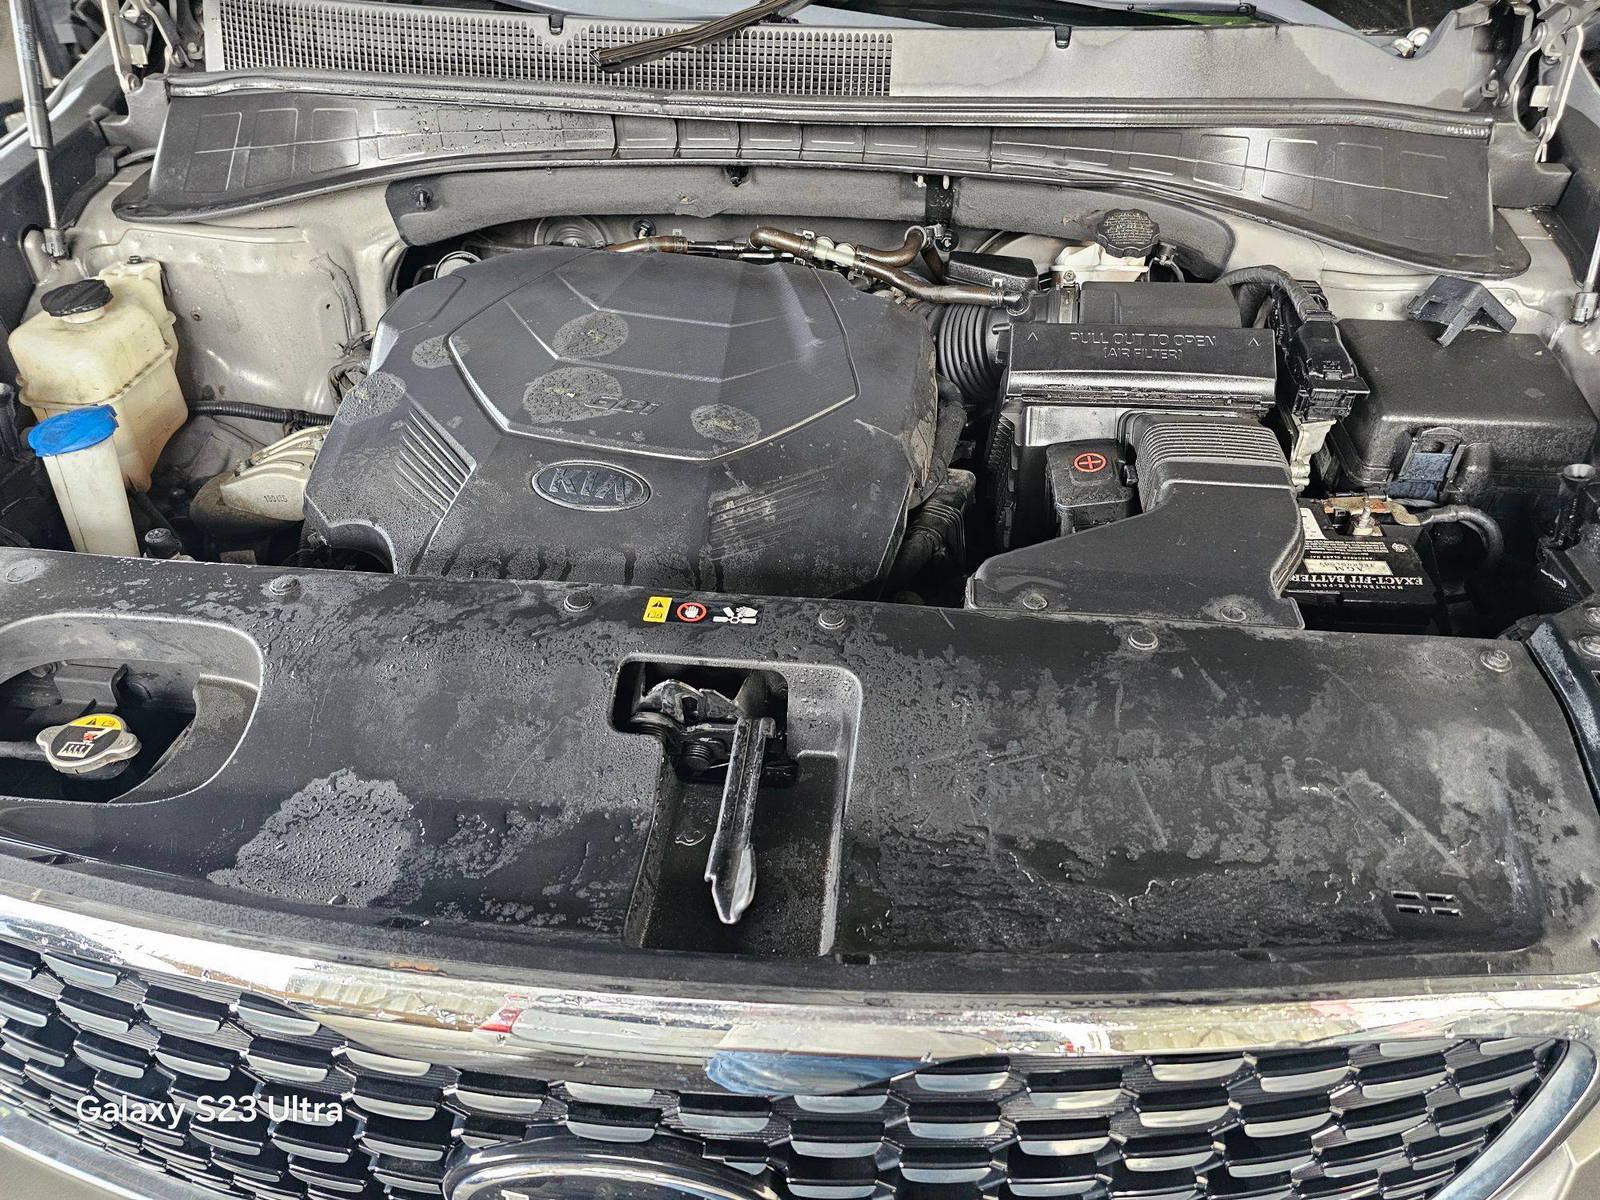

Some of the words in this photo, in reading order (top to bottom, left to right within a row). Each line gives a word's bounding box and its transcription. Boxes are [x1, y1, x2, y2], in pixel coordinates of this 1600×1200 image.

[1069, 332, 1109, 344] PULL
[1112, 332, 1145, 345] OUT
[1148, 333, 1169, 346] TO
[1173, 334, 1217, 347] OPEN
[548, 467, 627, 503] KIA
[1291, 574, 1346, 583] BATTER
[1351, 574, 1424, 586] EXACT-FIT
